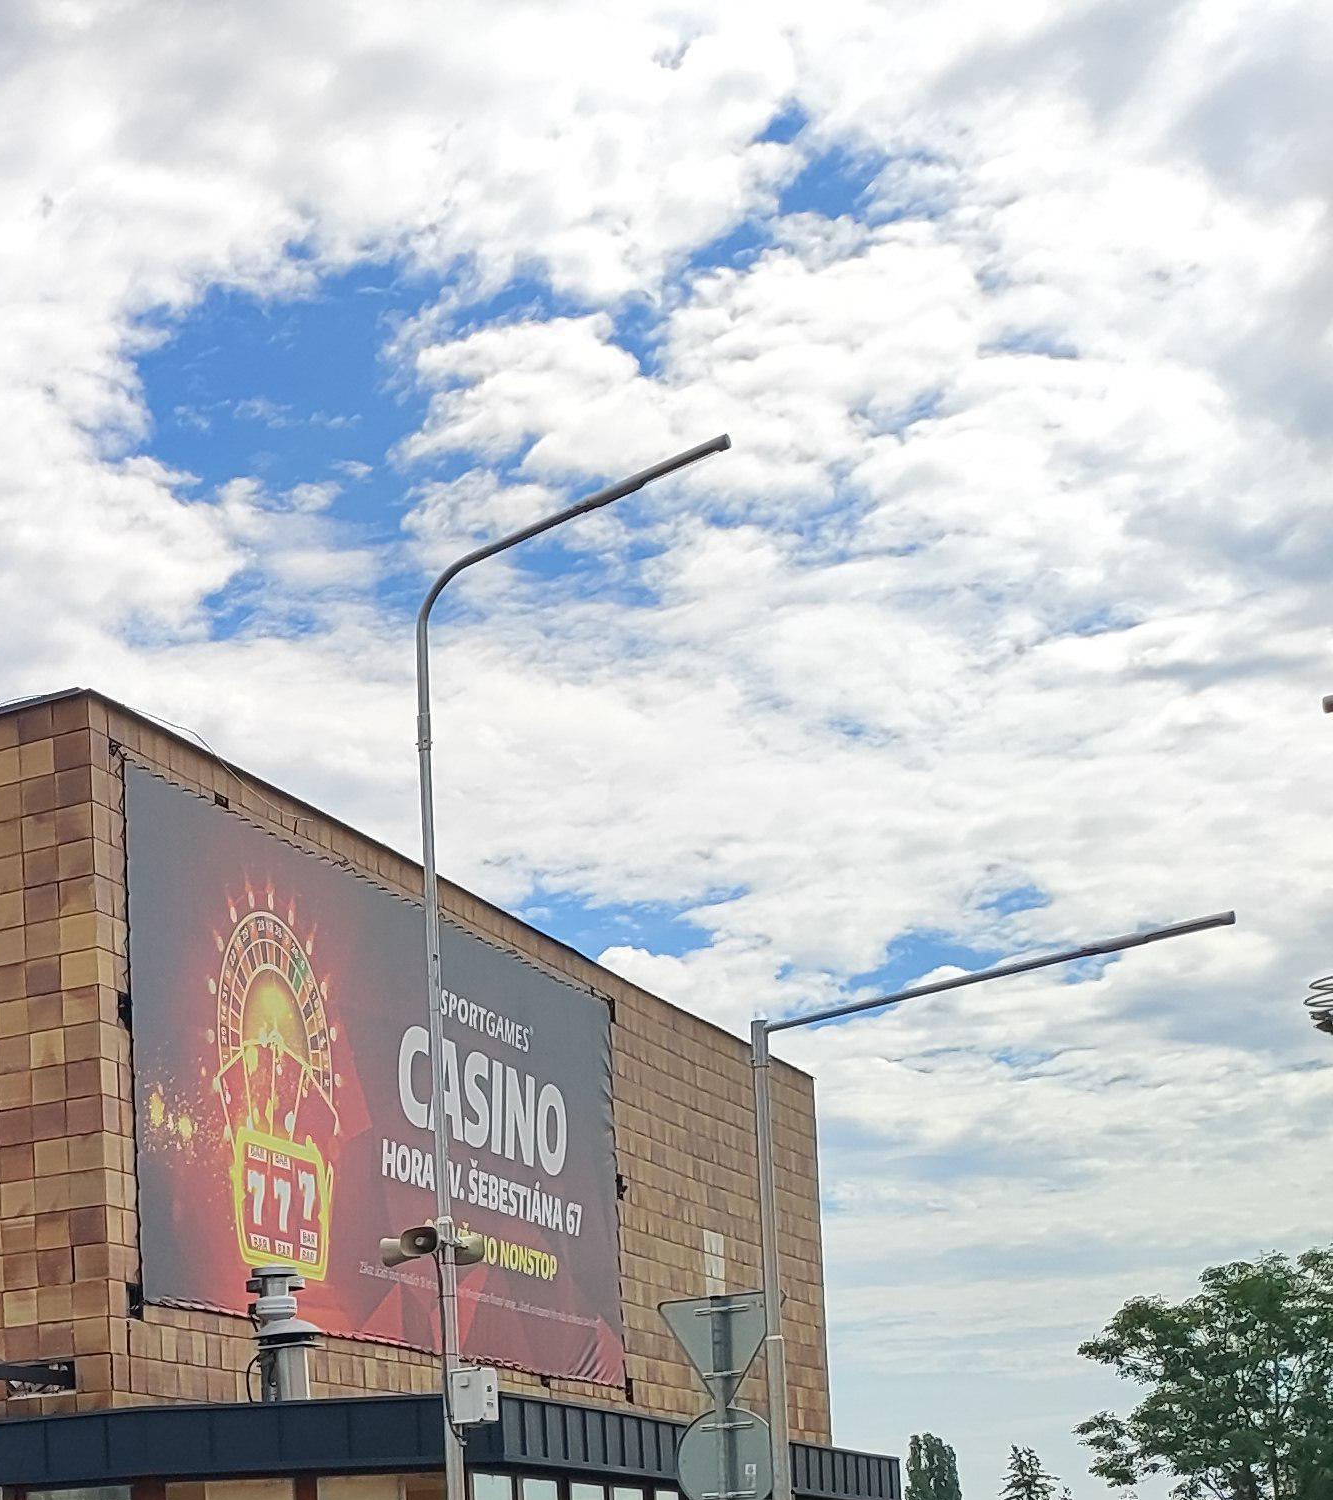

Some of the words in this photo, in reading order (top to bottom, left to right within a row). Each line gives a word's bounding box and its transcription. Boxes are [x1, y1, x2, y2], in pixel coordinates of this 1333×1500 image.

[440, 989, 530, 1053] SPORTGAMES
[398, 1025, 568, 1176] CASINO
[382, 1138, 436, 1192] HORA
[468, 1157, 564, 1233] ŠEBESTIÁNA
[565, 1202, 583, 1237] 67
[499, 1240, 558, 1282] NONSTOP
